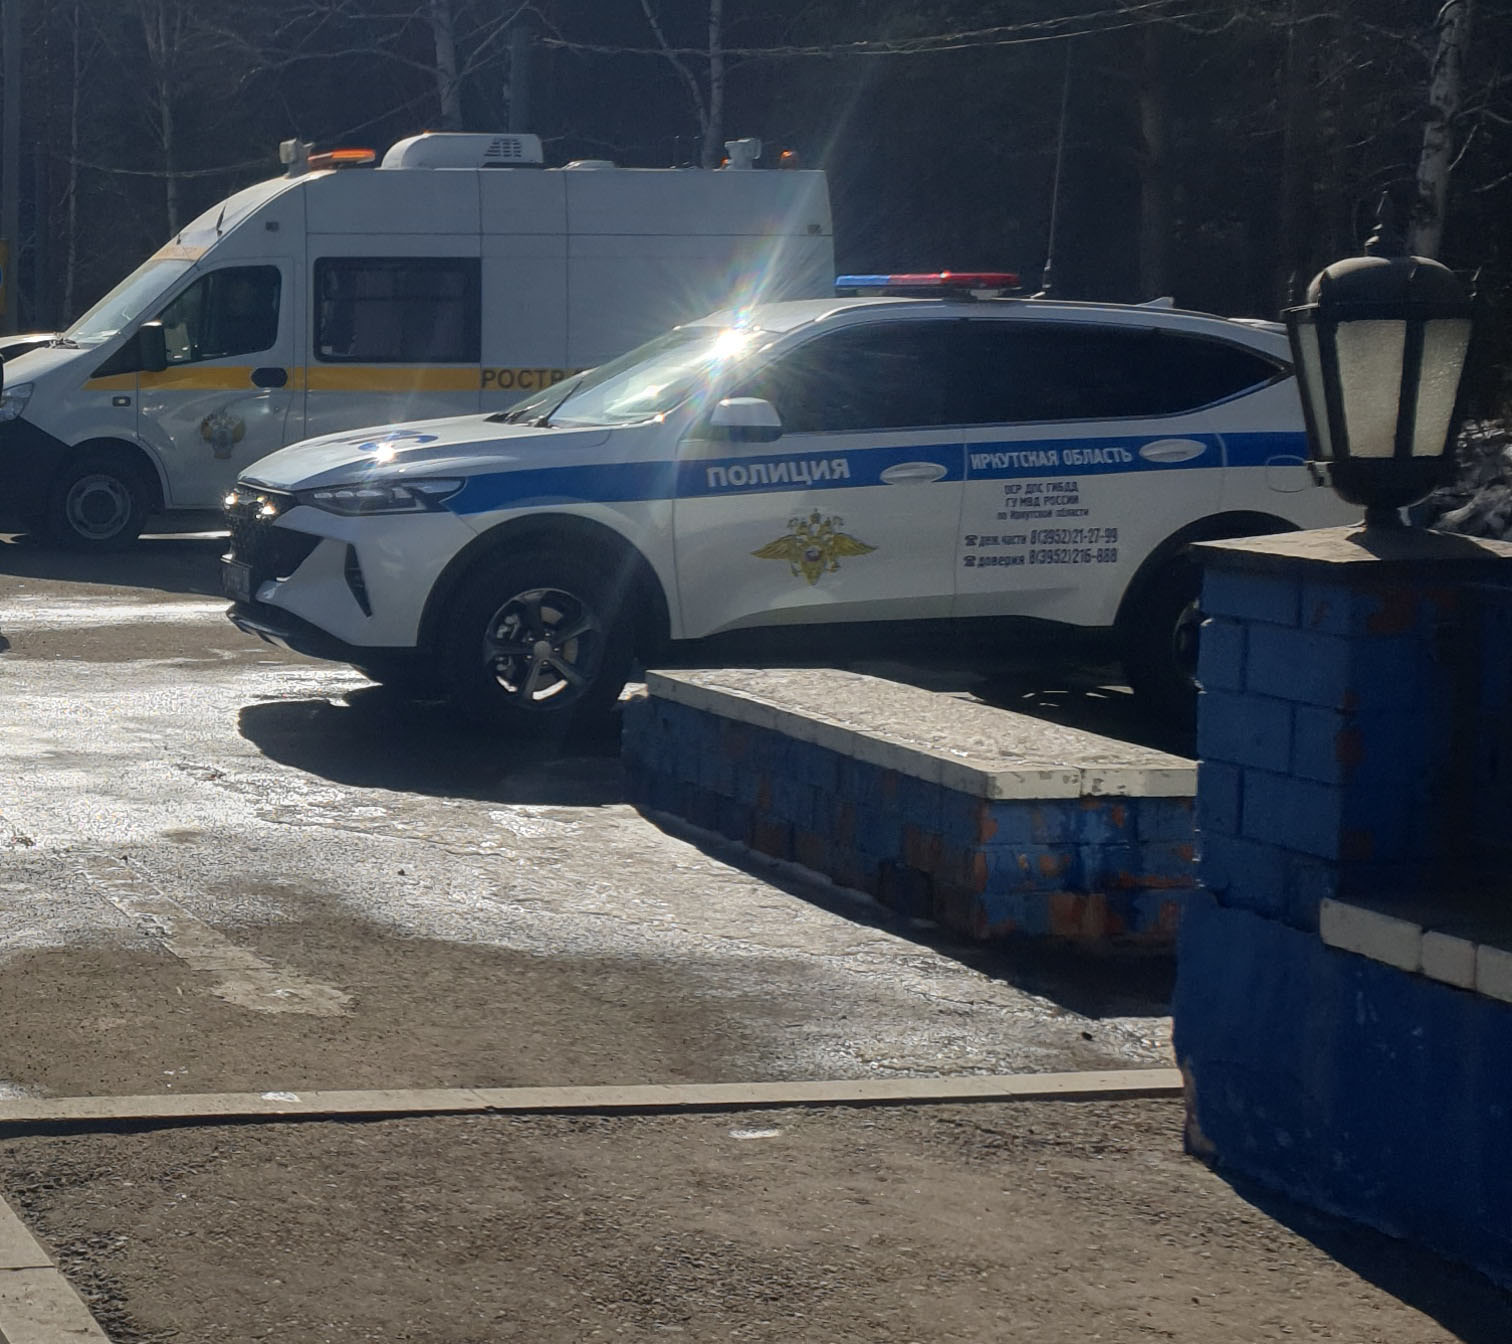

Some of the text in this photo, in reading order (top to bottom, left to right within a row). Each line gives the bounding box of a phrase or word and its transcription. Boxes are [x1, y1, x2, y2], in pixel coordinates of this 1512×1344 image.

[481, 368, 587, 390] РОСТР
[970, 446, 1133, 470] ИРКУТСКАЯ ОБЛАСТЬ
[706, 457, 851, 488] ПОЛИЦИЯ
[1025, 483, 1043, 494] ДПС
[1046, 481, 1079, 493] ГИБДД
[1005, 494, 1079, 507] ГУ МВД РОССИИ
[1030, 527, 1118, 545] 8(3952)21-27-99
[977, 547, 1118, 568] доверия 8(3952)216-888
